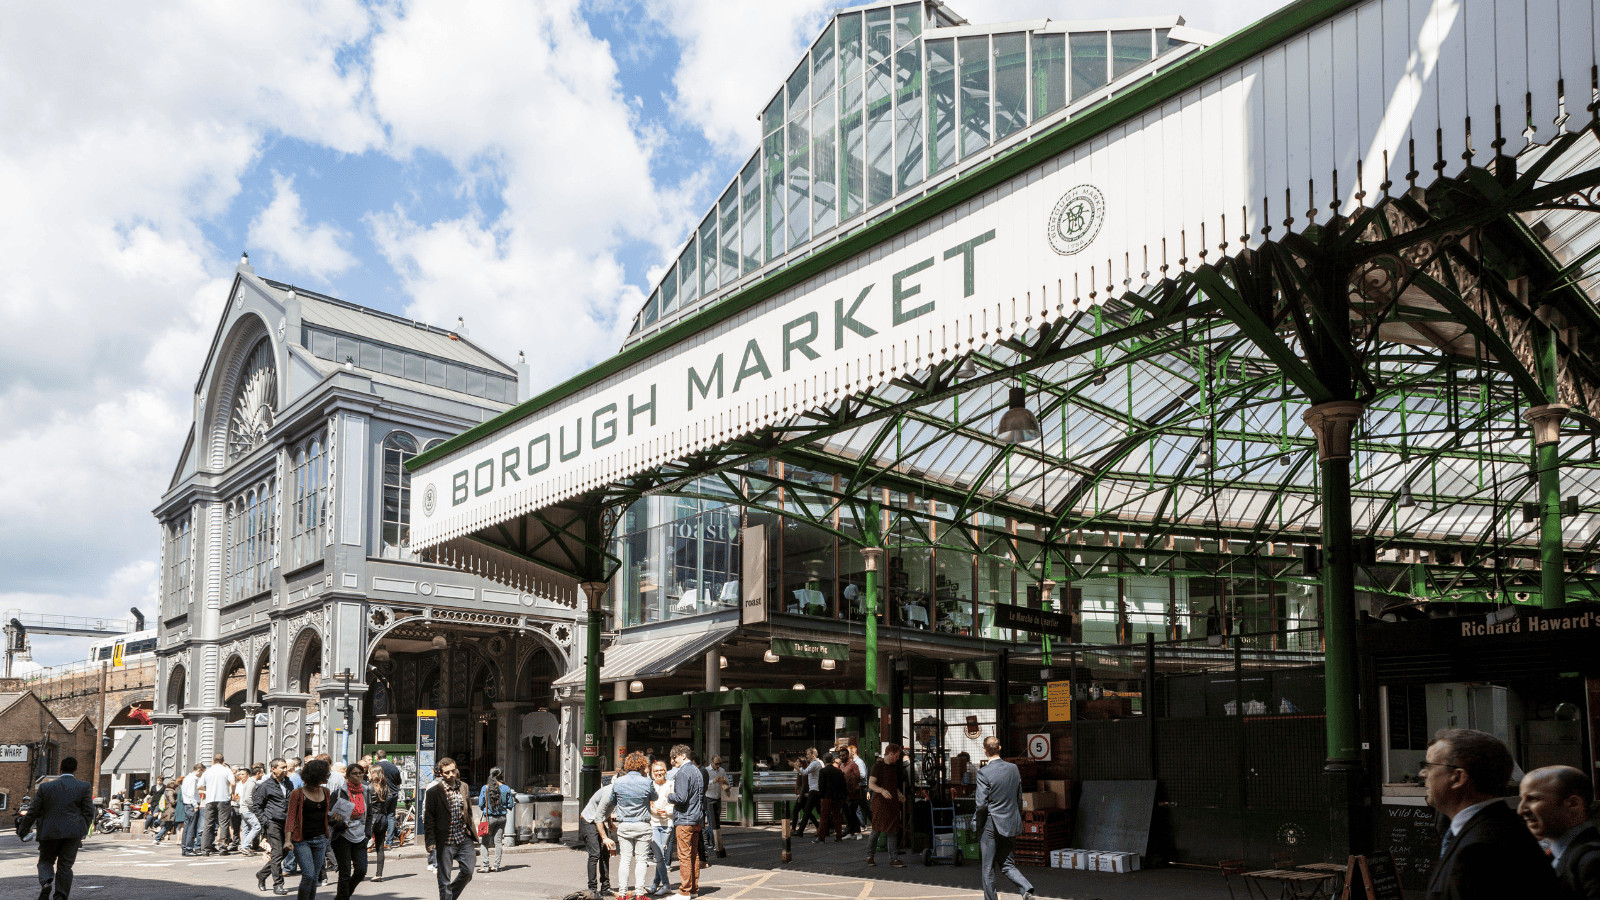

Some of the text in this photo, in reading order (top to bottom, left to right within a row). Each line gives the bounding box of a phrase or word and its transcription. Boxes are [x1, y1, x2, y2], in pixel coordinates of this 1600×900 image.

[1051, 191, 1078, 239] BOROUGH
[1083, 189, 1102, 219] MARKET
[451, 228, 996, 507] BOROUGH MARKET
[745, 597, 762, 607] roast
[1461, 611, 1600, 637] Richard Haward's
[794, 643, 828, 655] The Ginger Pig
[5, 748, 22, 757] WHARF
[1036, 742, 1043, 752] 5
[1388, 808, 1412, 818] Wild
